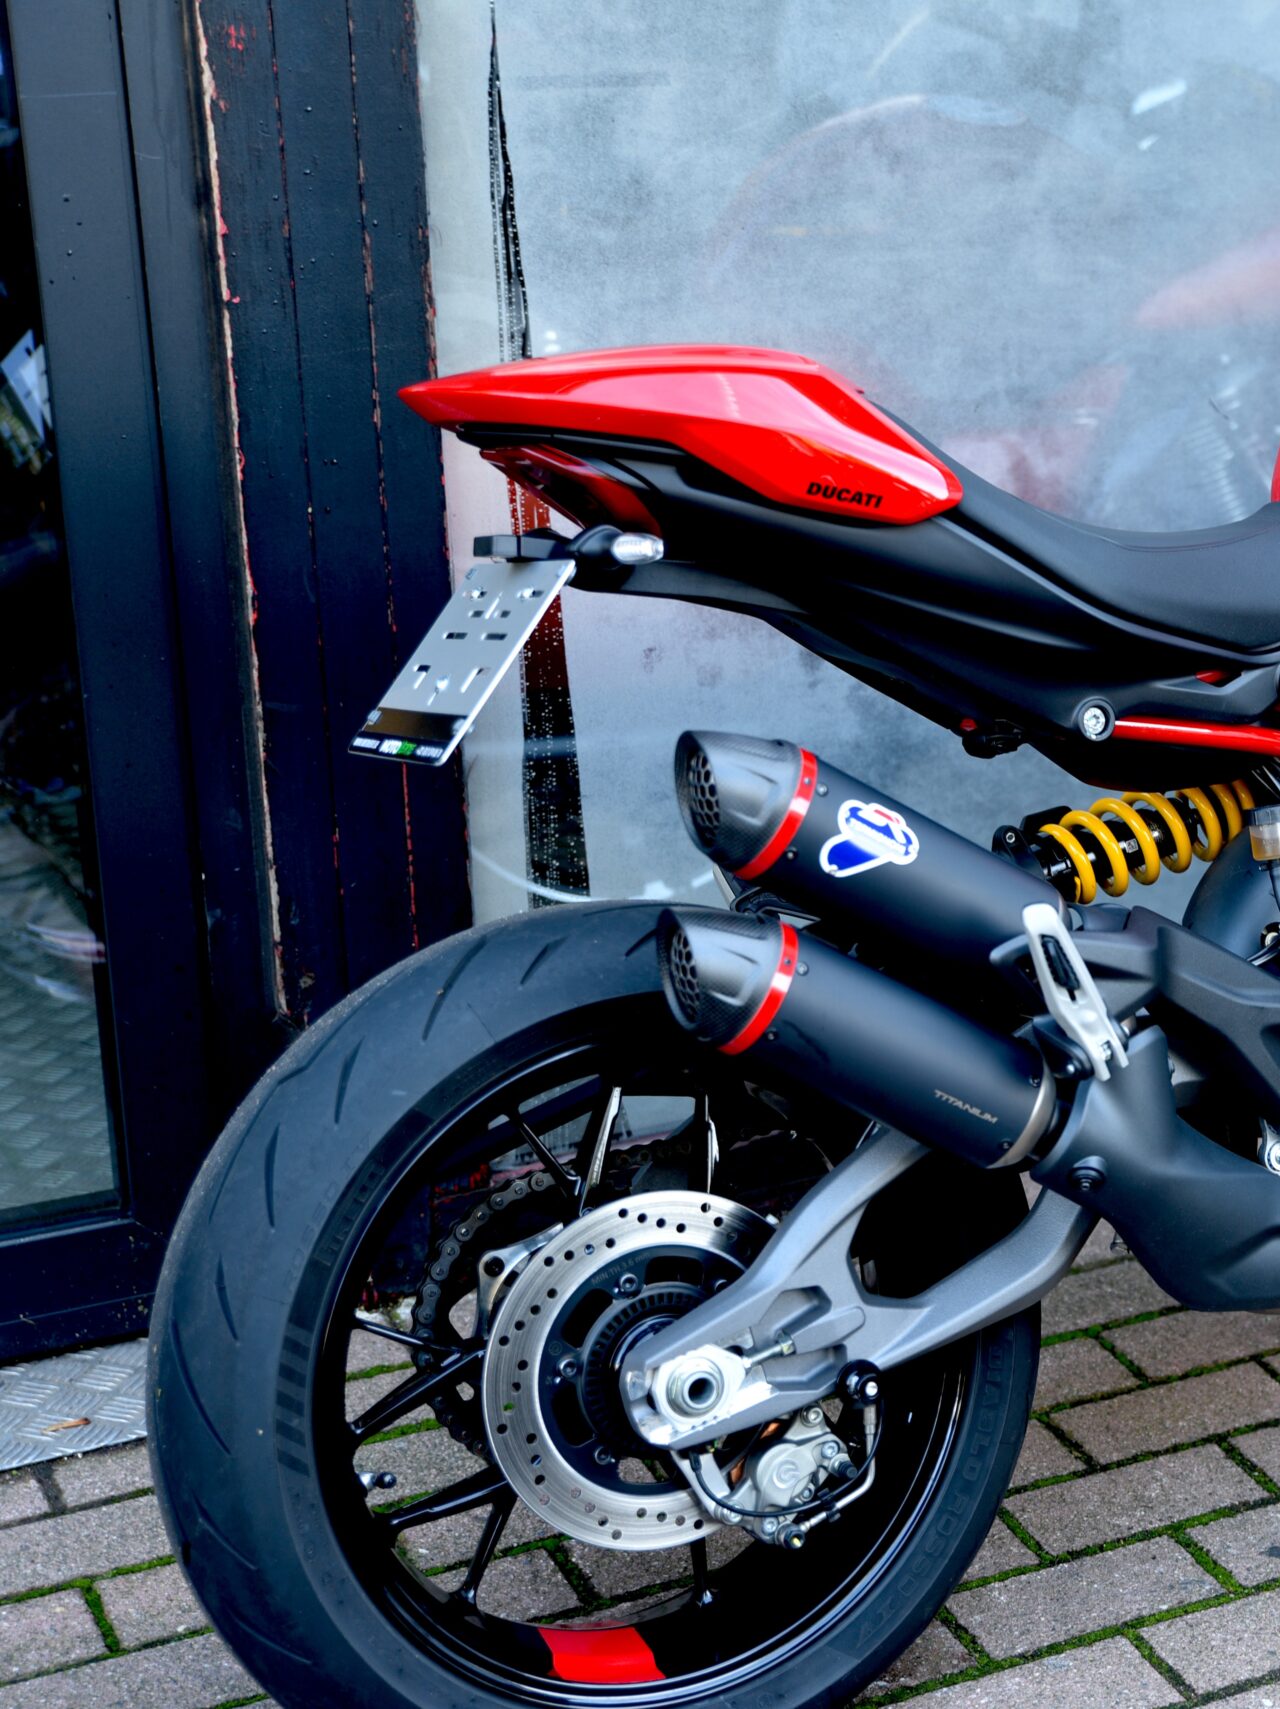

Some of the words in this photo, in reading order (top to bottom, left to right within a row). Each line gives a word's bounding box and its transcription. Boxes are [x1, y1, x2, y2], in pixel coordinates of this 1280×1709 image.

[806, 482, 883, 509] DUCATI
[934, 1088, 998, 1124] TITANIUM
[897, 1491, 971, 1597] ROSSO
